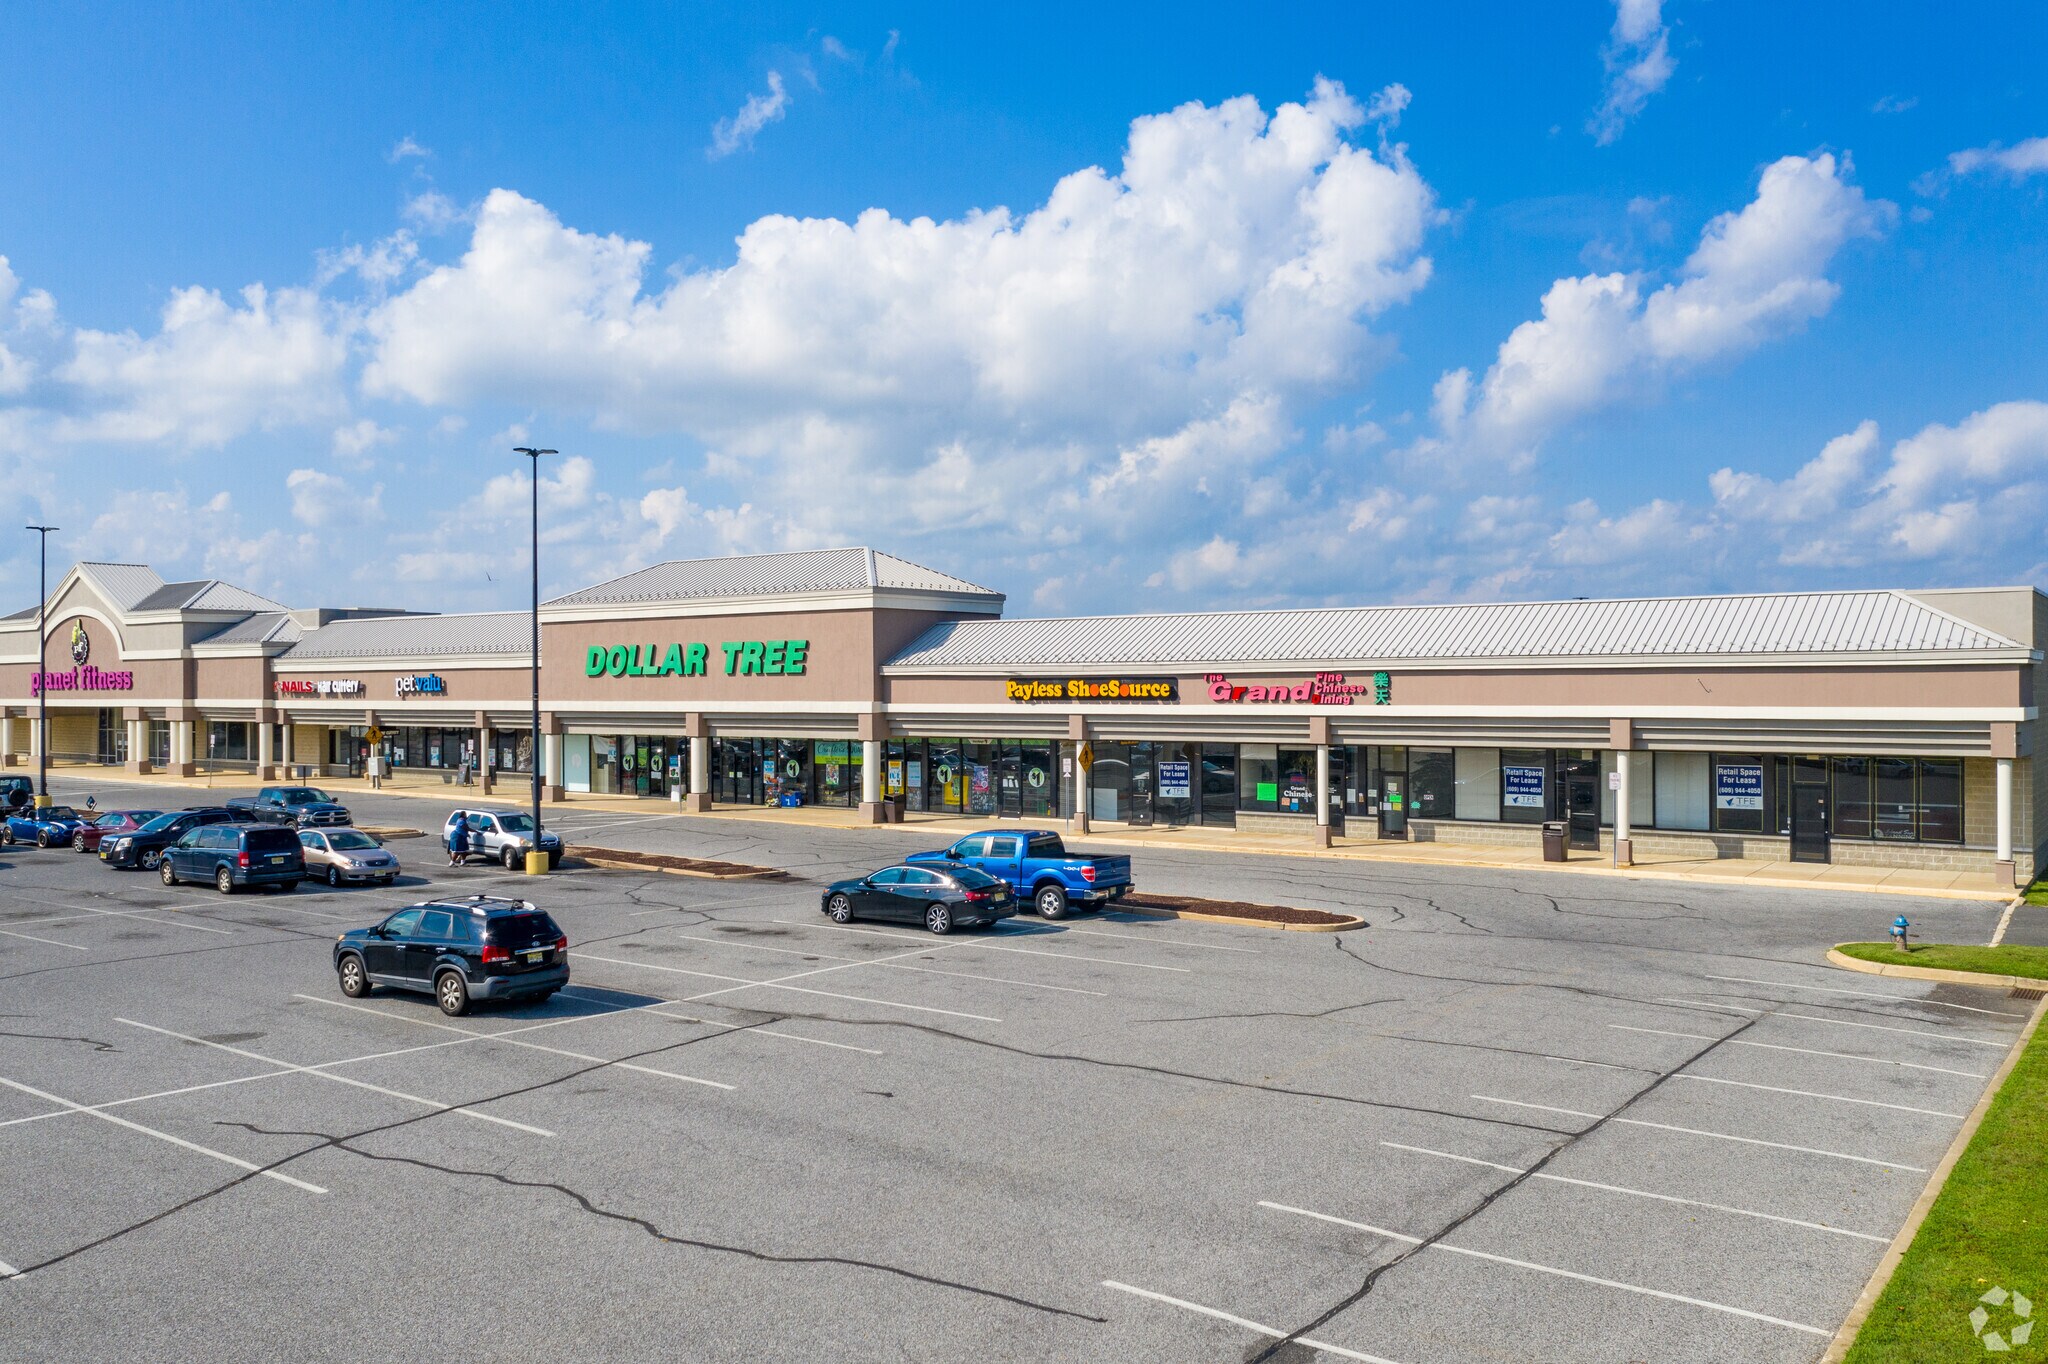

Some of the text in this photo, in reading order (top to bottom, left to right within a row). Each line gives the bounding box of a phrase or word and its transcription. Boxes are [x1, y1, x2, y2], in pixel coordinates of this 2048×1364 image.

[585, 639, 808, 676] DOLLAR TREE
[31, 664, 132, 697] panet fitness
[1316, 672, 1343, 683] Fine
[281, 680, 314, 693] NAILS
[1006, 680, 1171, 701] Payless ShoeSource
[1208, 681, 1312, 702] Grand
[1314, 682, 1365, 694] Chinese
[1311, 693, 1352, 706] Dining
[1740, 768, 1761, 777] Space
[1736, 797, 1755, 805] TFE
